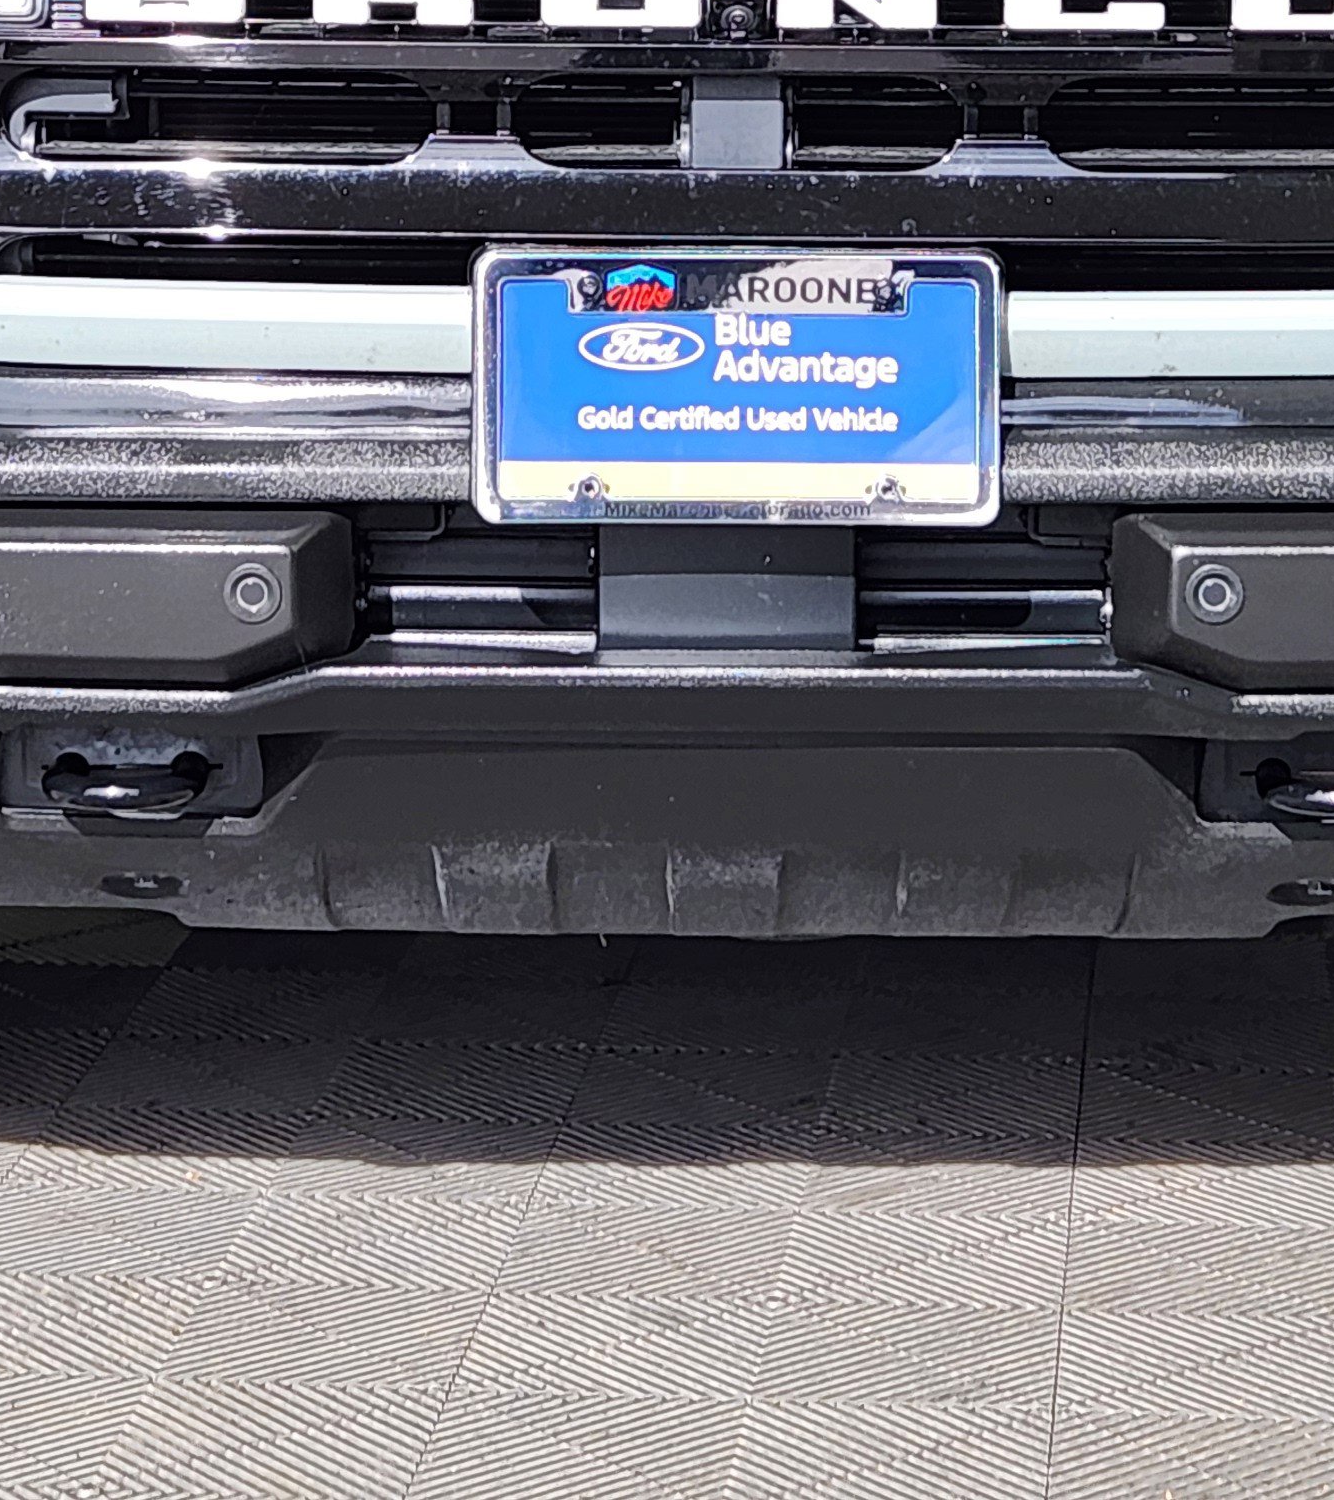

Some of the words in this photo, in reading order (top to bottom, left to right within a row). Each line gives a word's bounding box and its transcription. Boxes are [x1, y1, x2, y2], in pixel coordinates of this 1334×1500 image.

[602, 329, 679, 362] Ford
[714, 312, 791, 347] Blue
[713, 349, 899, 389] Advantage
[577, 405, 634, 430] Gold
[639, 405, 740, 431] Certified
[746, 406, 807, 431] Used
[812, 406, 899, 432] Vehicle
